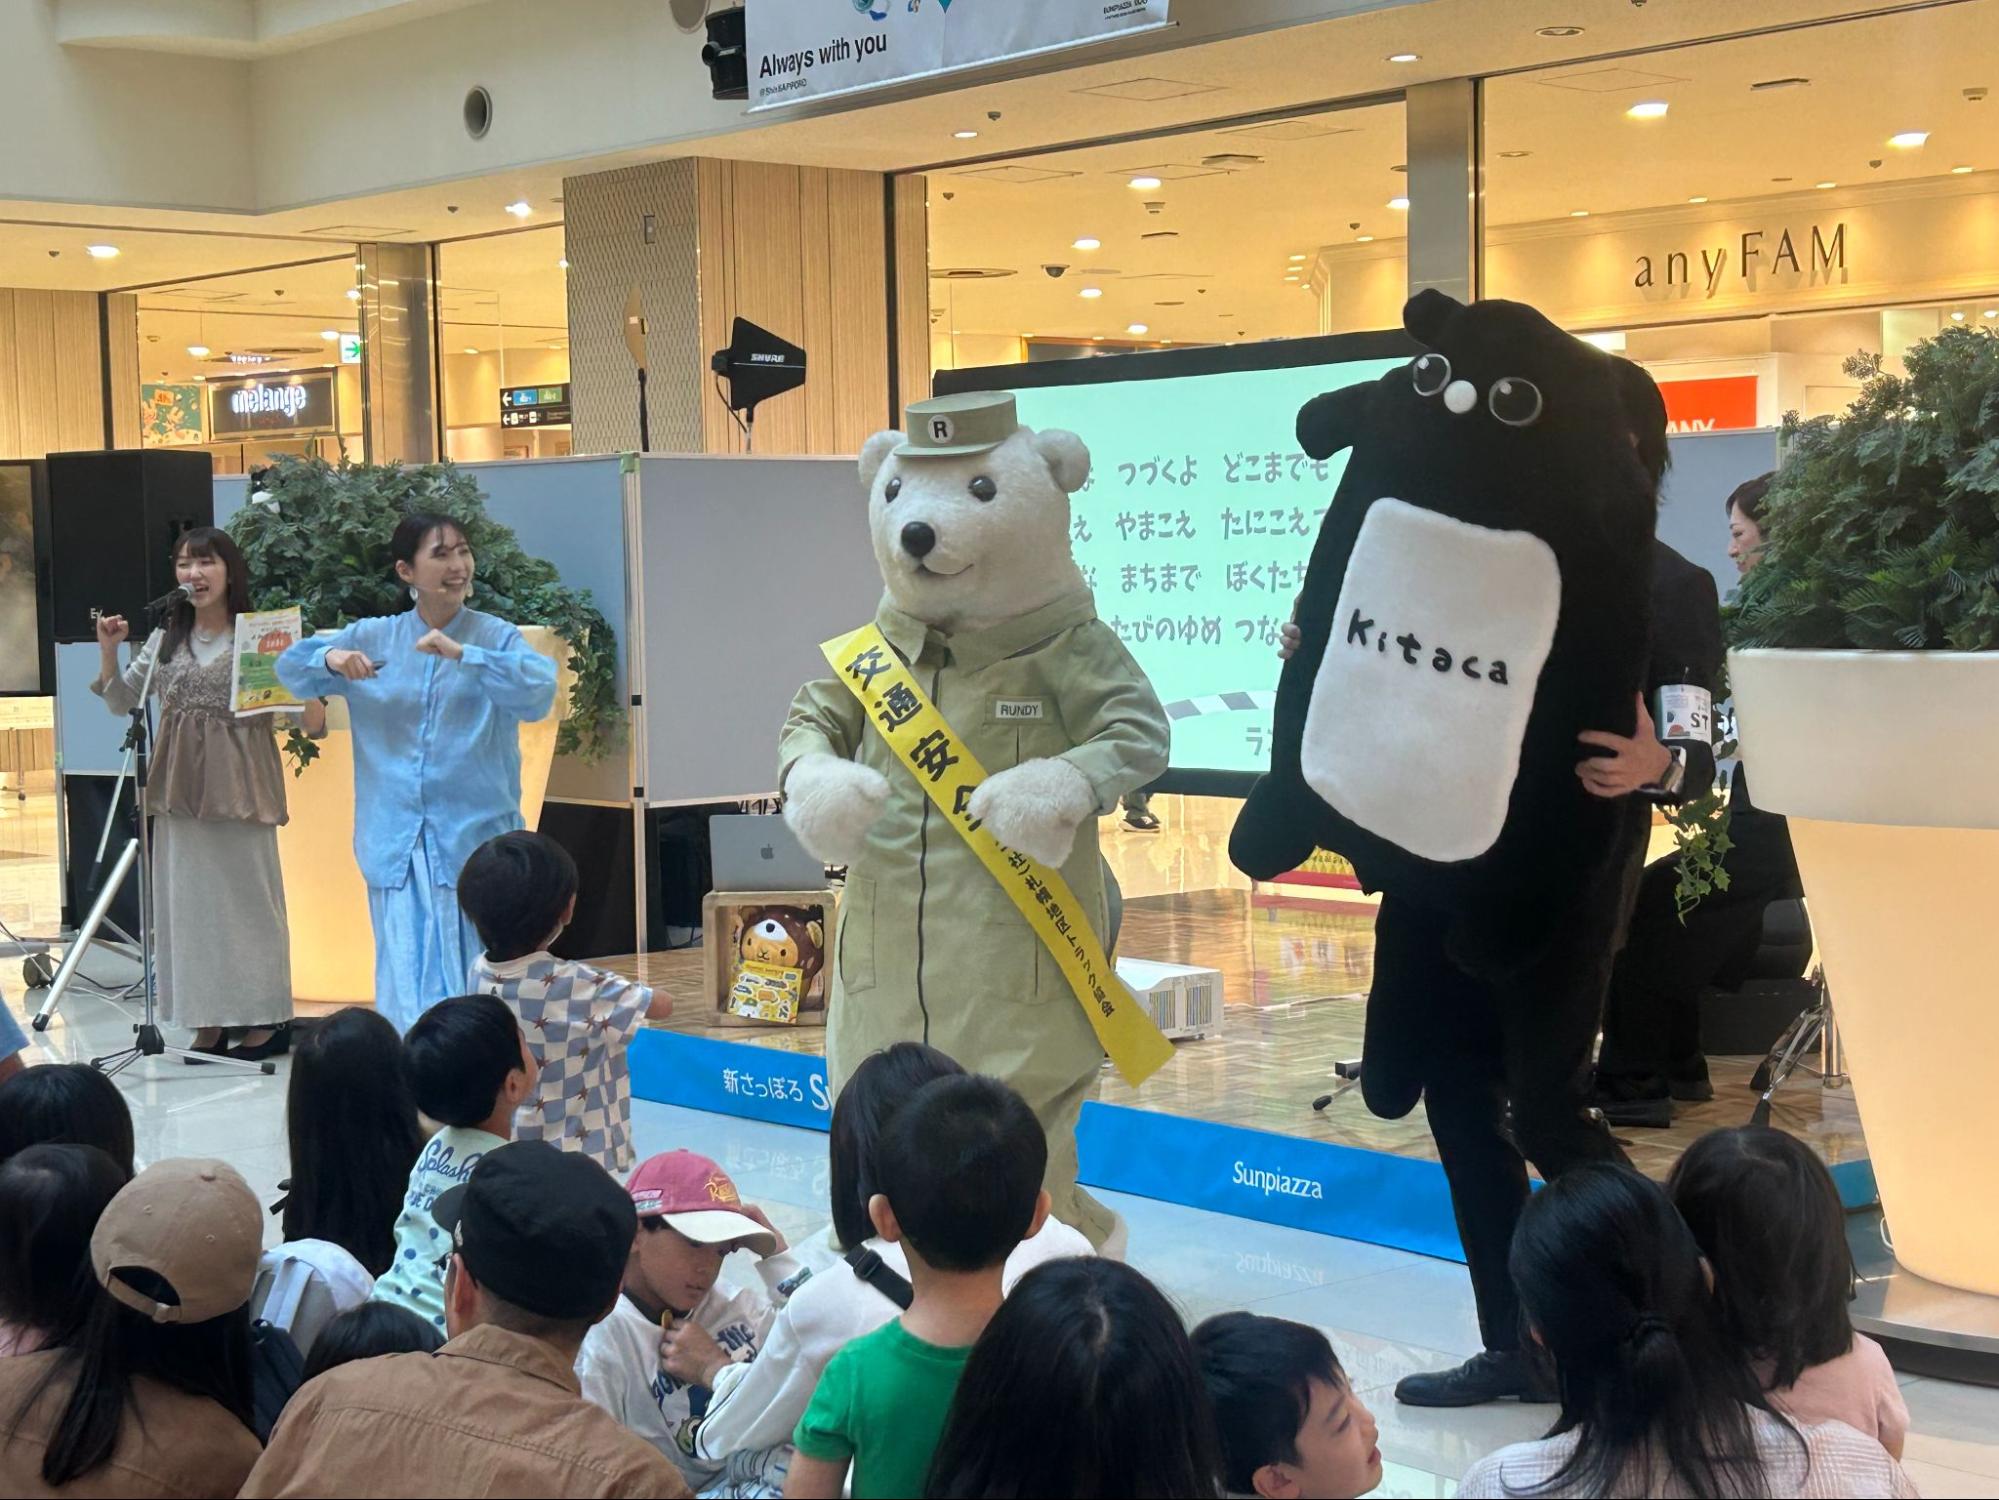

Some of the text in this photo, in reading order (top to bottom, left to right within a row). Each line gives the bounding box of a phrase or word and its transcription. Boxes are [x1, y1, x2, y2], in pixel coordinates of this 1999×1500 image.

[760, 34, 887, 78] Always with you
[750, 353, 785, 363] SHURE
[231, 383, 307, 418] melange
[933, 420, 948, 438] R
[1118, 455, 1198, 486] つづくよ
[1223, 451, 1329, 483] どこまでも
[1115, 510, 1197, 541] やまこえ
[1120, 562, 1203, 594] まちまで
[1110, 614, 1222, 646] たびのゆめ
[1347, 608, 1509, 686] Kitaca
[1000, 704, 1039, 717] RUNDY
[1245, 726, 1272, 756] ラ
[722, 1067, 804, 1102] 新さっぽろ
[418, 1138, 484, 1183] Splash
[1232, 1160, 1323, 1199] Sunpiazza
